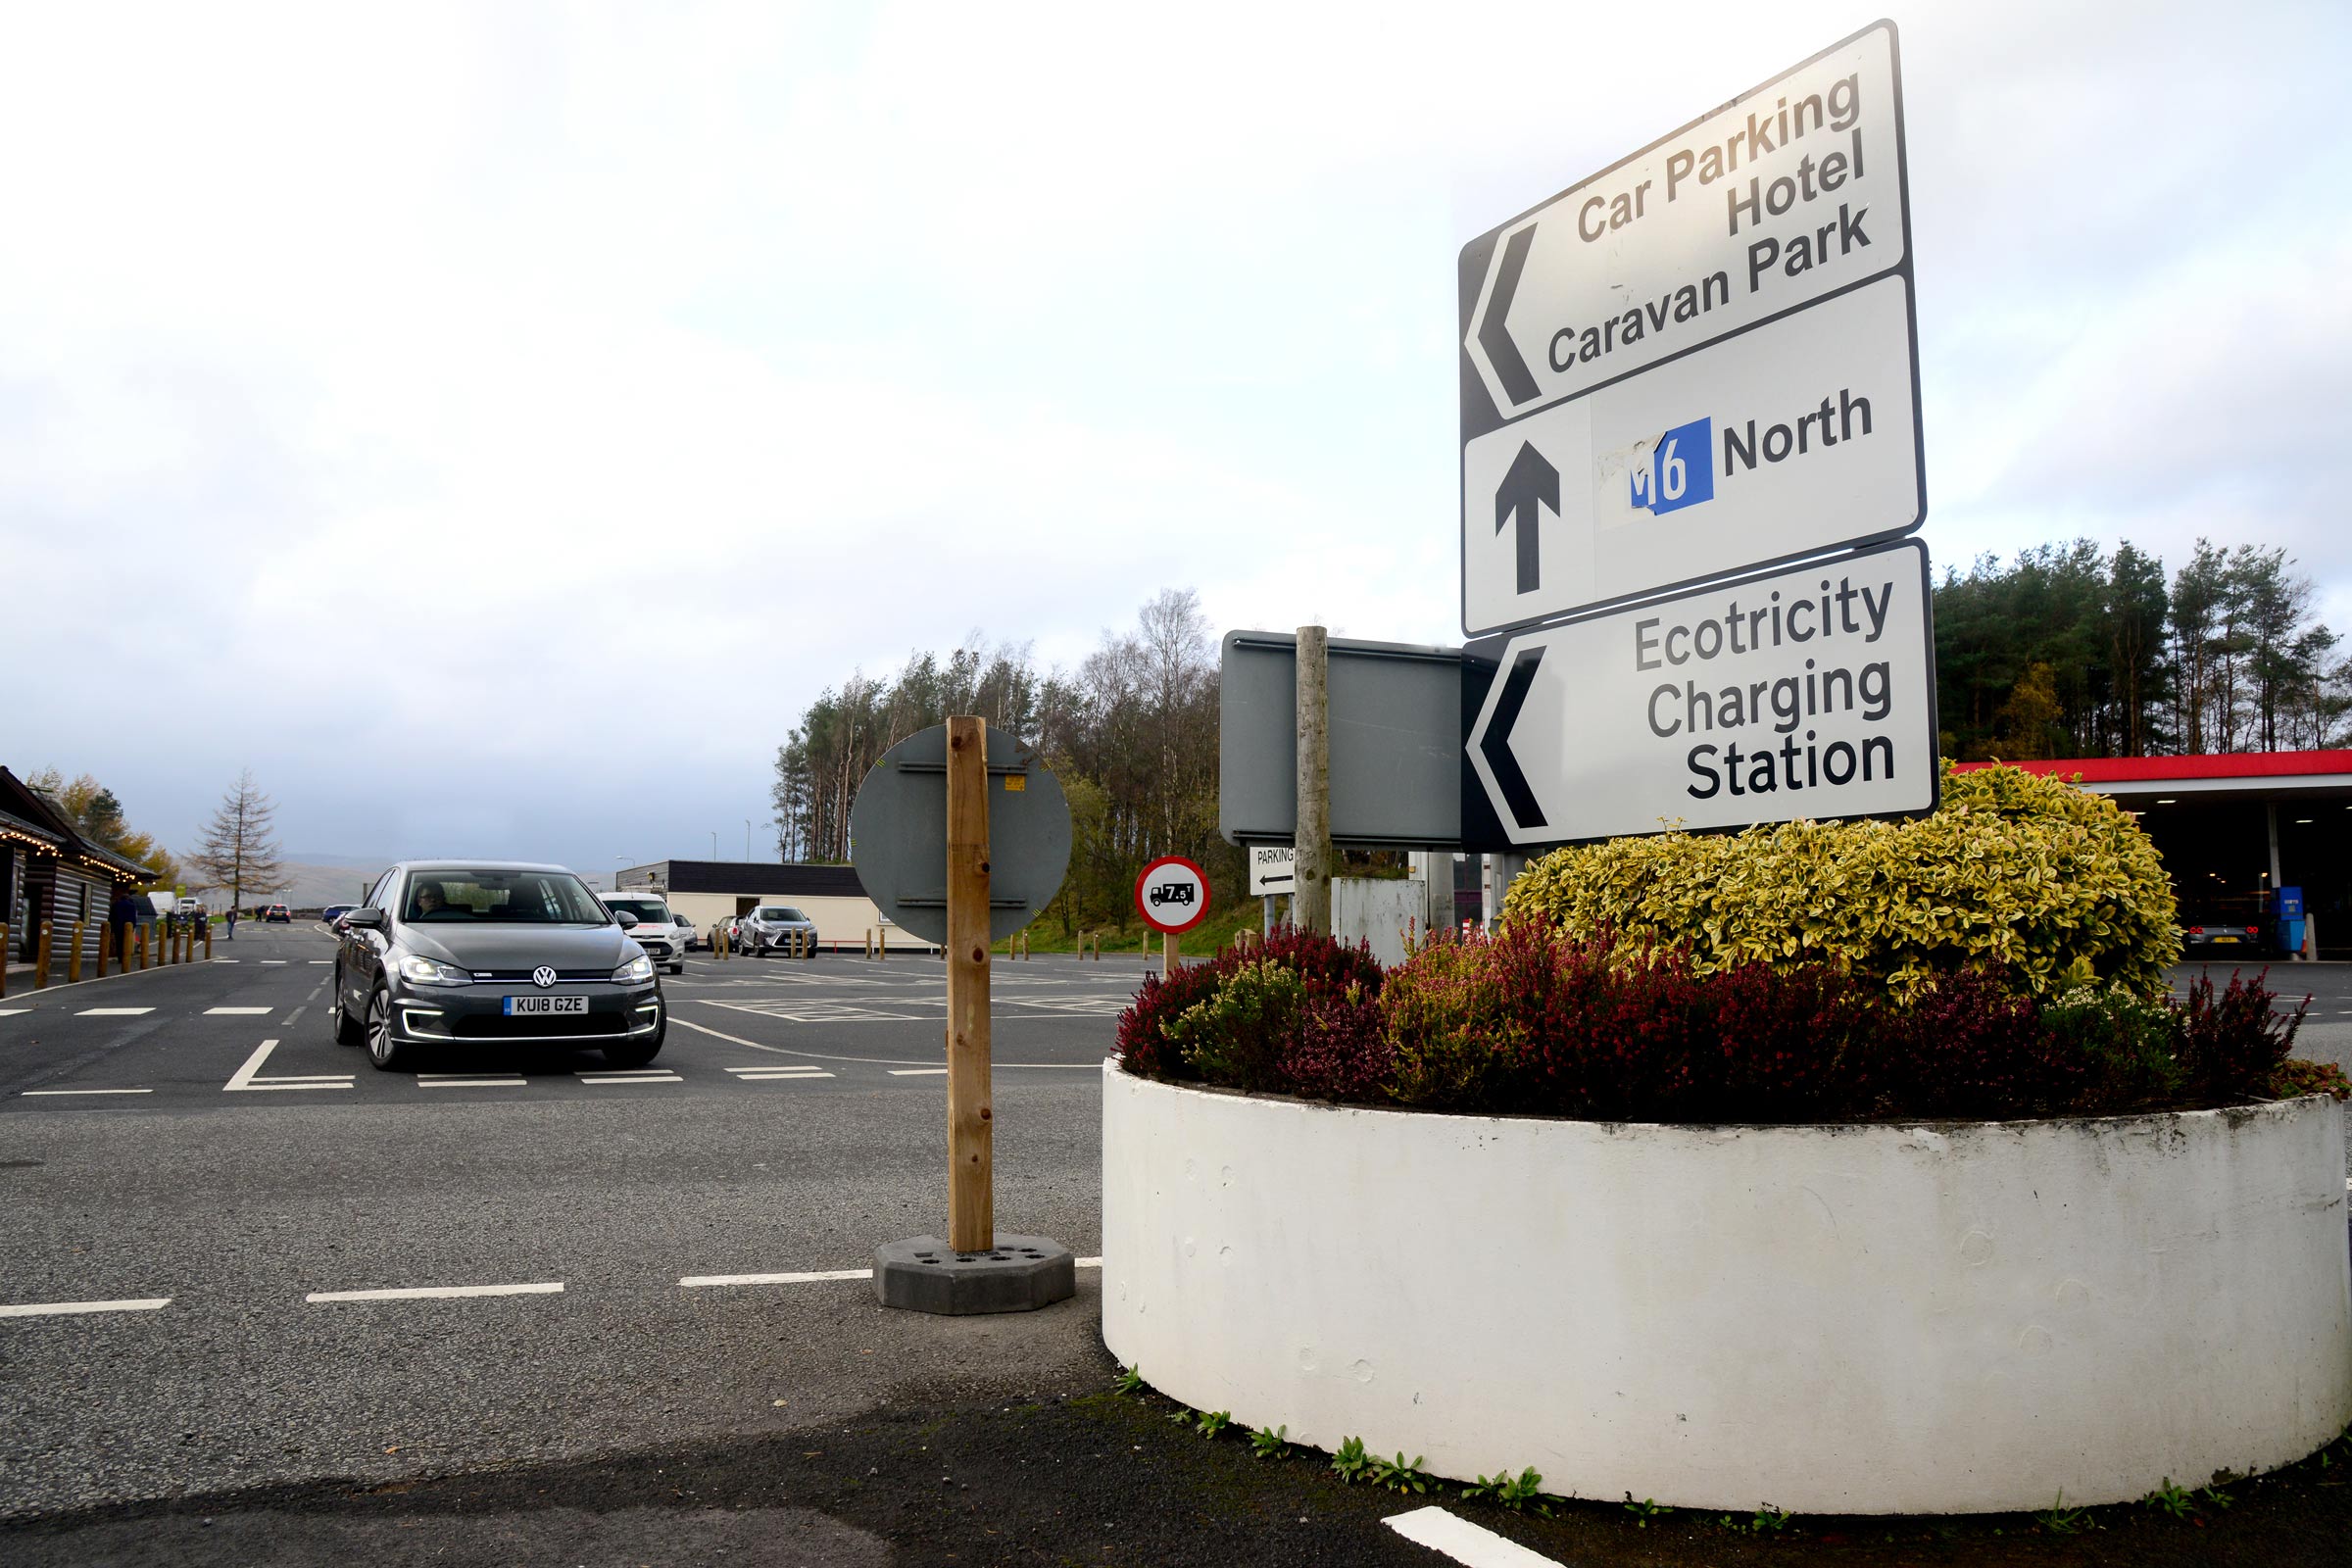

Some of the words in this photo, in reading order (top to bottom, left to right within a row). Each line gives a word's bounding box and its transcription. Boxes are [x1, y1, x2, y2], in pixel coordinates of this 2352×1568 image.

[1578, 178, 1651, 243] Car
[1666, 73, 1860, 202] Parking
[1728, 127, 1864, 236] Hotel
[1548, 270, 1729, 372] Caravan
[1748, 204, 1872, 293] Park
[1724, 389, 1872, 476] North
[1636, 576, 1893, 671] Ecotricity
[1648, 659, 1891, 737] Charging
[1688, 730, 1893, 800] Station
[1257, 848, 1294, 864] PARKING
[516, 998, 550, 1011] KU18
[555, 998, 583, 1011] GZE
